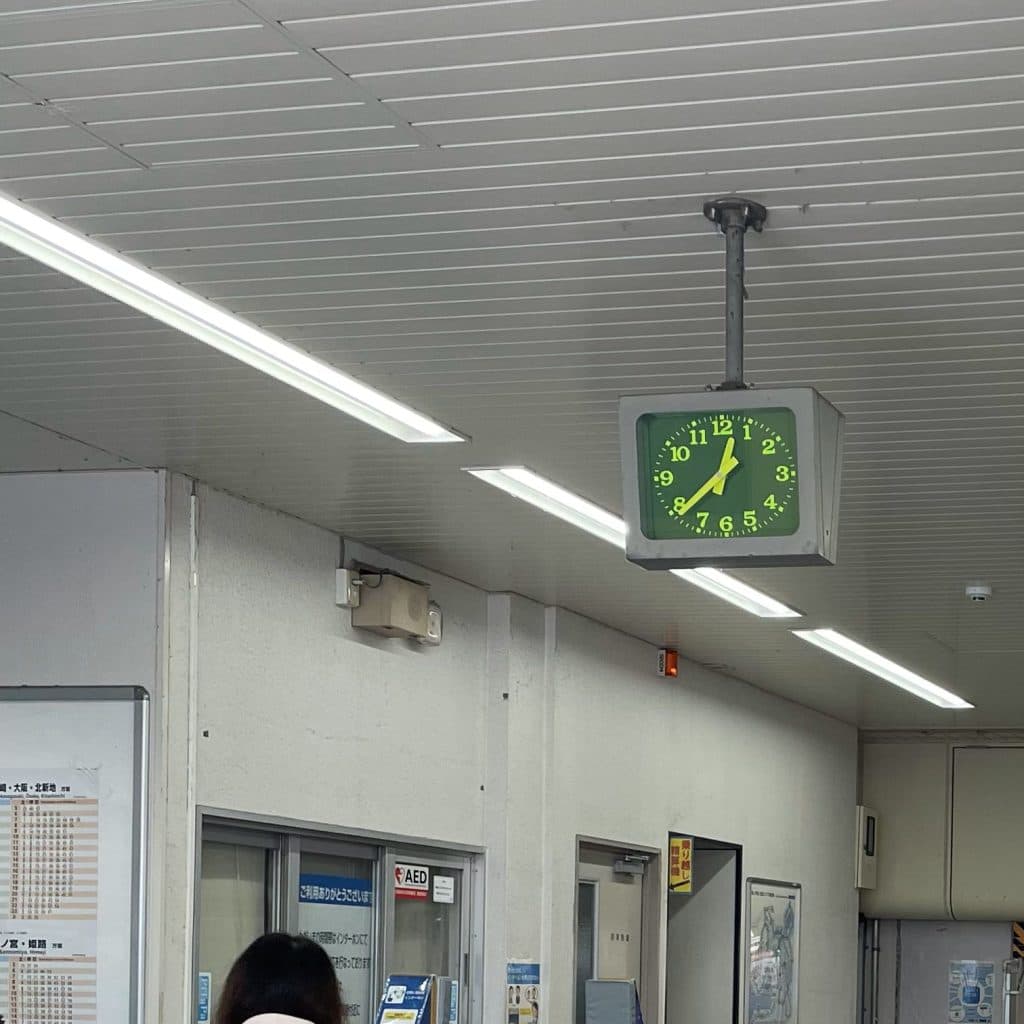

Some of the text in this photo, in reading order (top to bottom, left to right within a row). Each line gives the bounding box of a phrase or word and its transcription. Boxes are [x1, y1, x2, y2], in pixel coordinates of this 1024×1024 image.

[712, 420, 733, 436] 12
[742, 424, 752, 440] 1
[690, 430, 708, 444] 11
[671, 446, 690, 462] 10
[762, 439, 776, 454] 2
[660, 471, 674, 486] 9
[776, 466, 789, 482] 3
[673, 497, 686, 512] 8
[764, 494, 777, 509] 4
[696, 512, 709, 528] 7
[719, 516, 733, 532] 6
[744, 510, 756, 526] 5
[405, 869, 427, 884] AED
